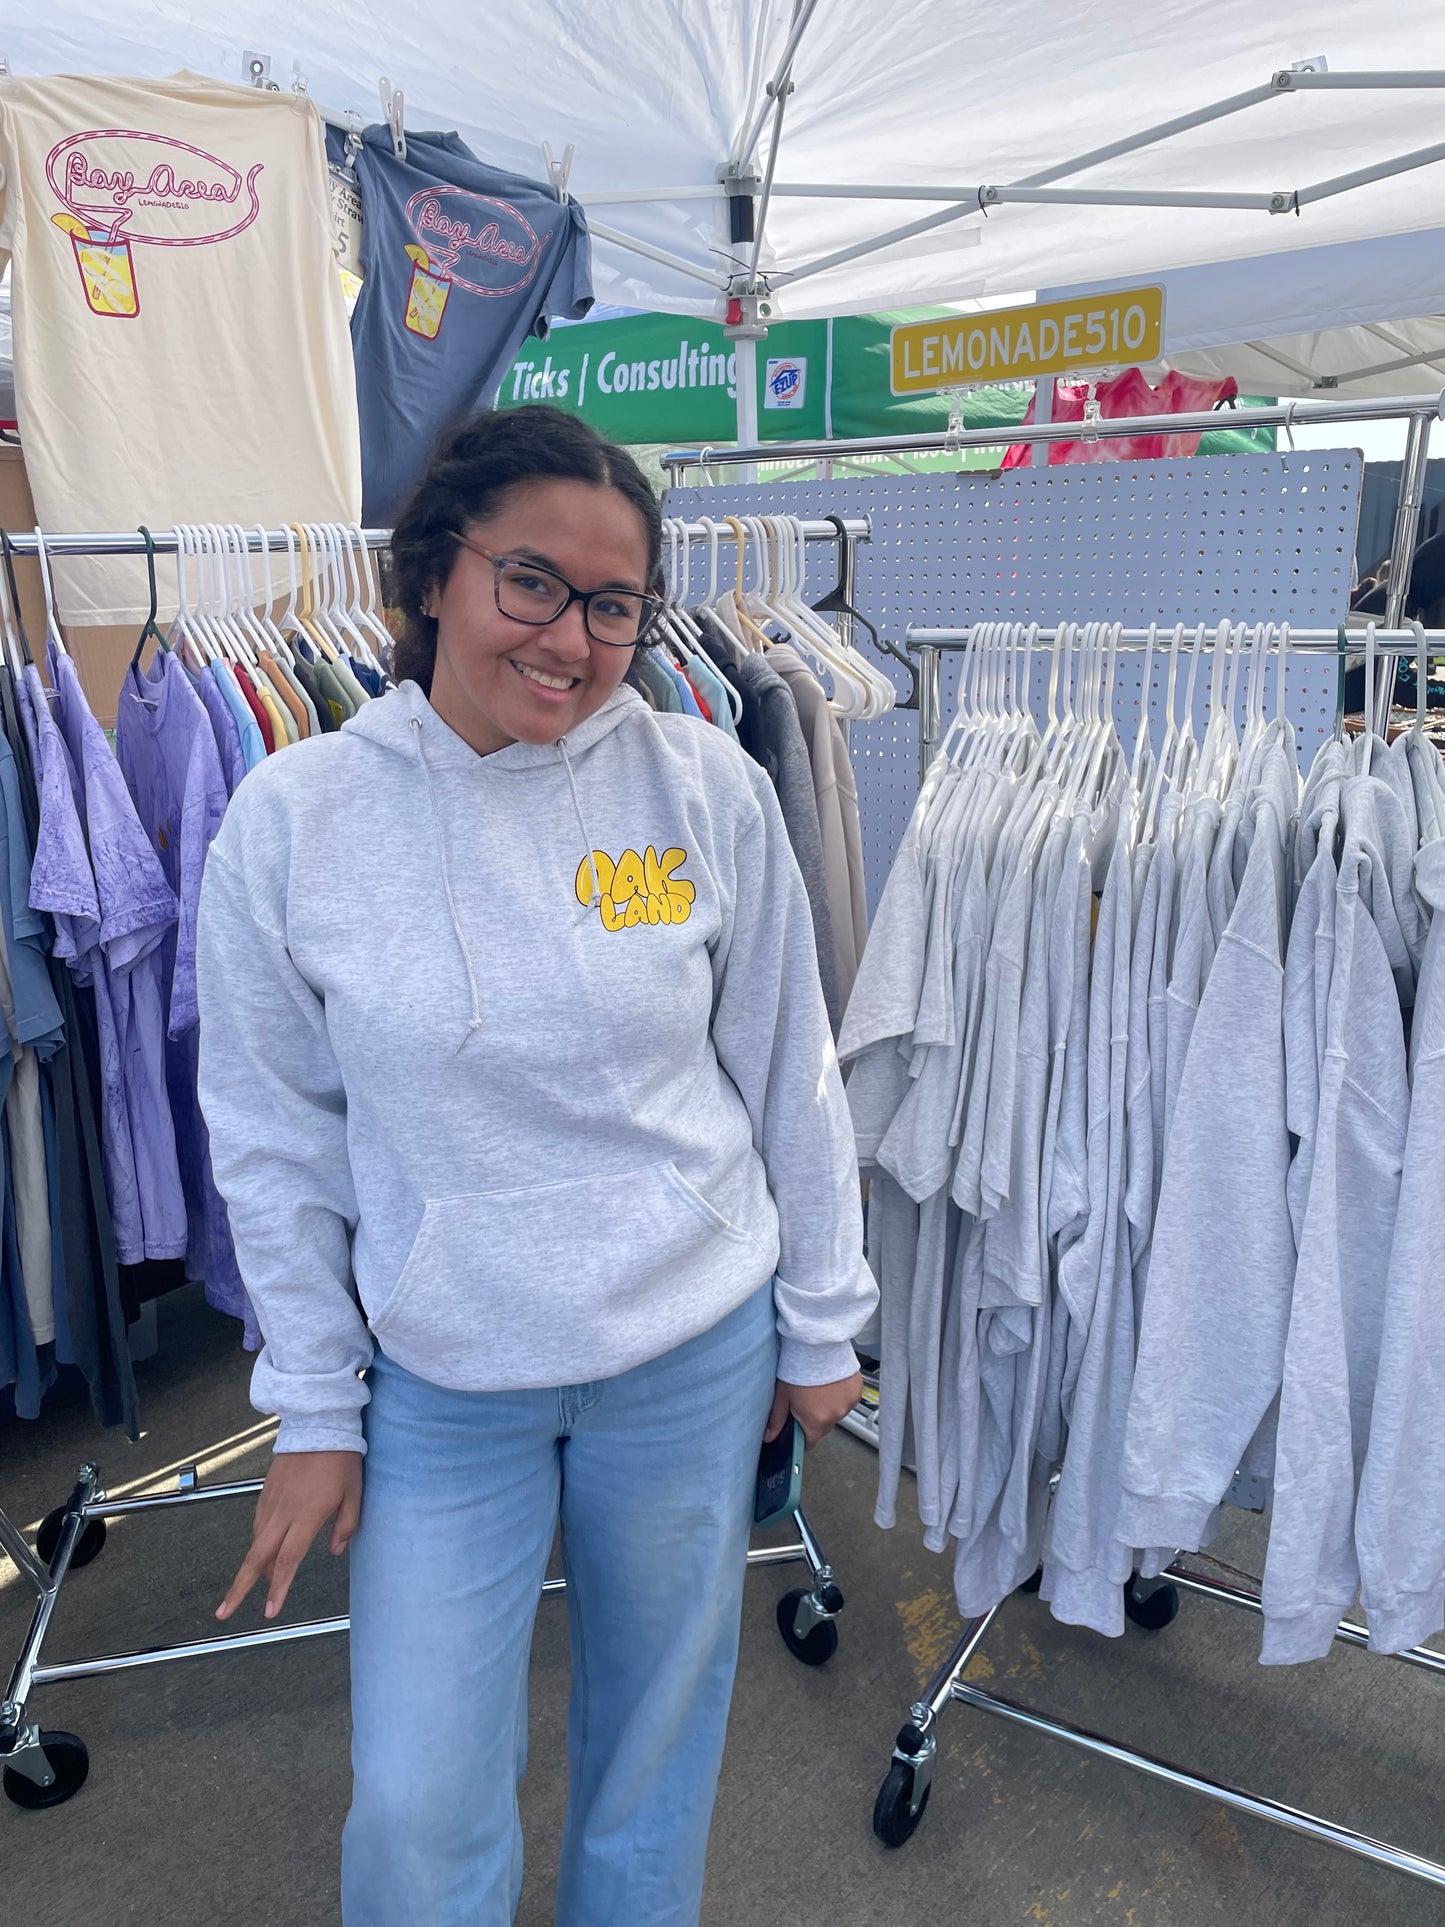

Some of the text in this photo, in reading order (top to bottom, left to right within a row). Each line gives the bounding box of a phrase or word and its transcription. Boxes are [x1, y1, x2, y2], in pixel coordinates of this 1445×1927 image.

[65, 152, 238, 205] Bay Area
[339, 187, 362, 210] Area
[337, 232, 349, 254] 5
[417, 199, 531, 266] Bay Area
[904, 305, 1146, 379] LEMONADE510
[512, 356, 571, 401] Ticks
[574, 844, 697, 908] OAK
[600, 892, 692, 933] LAND
